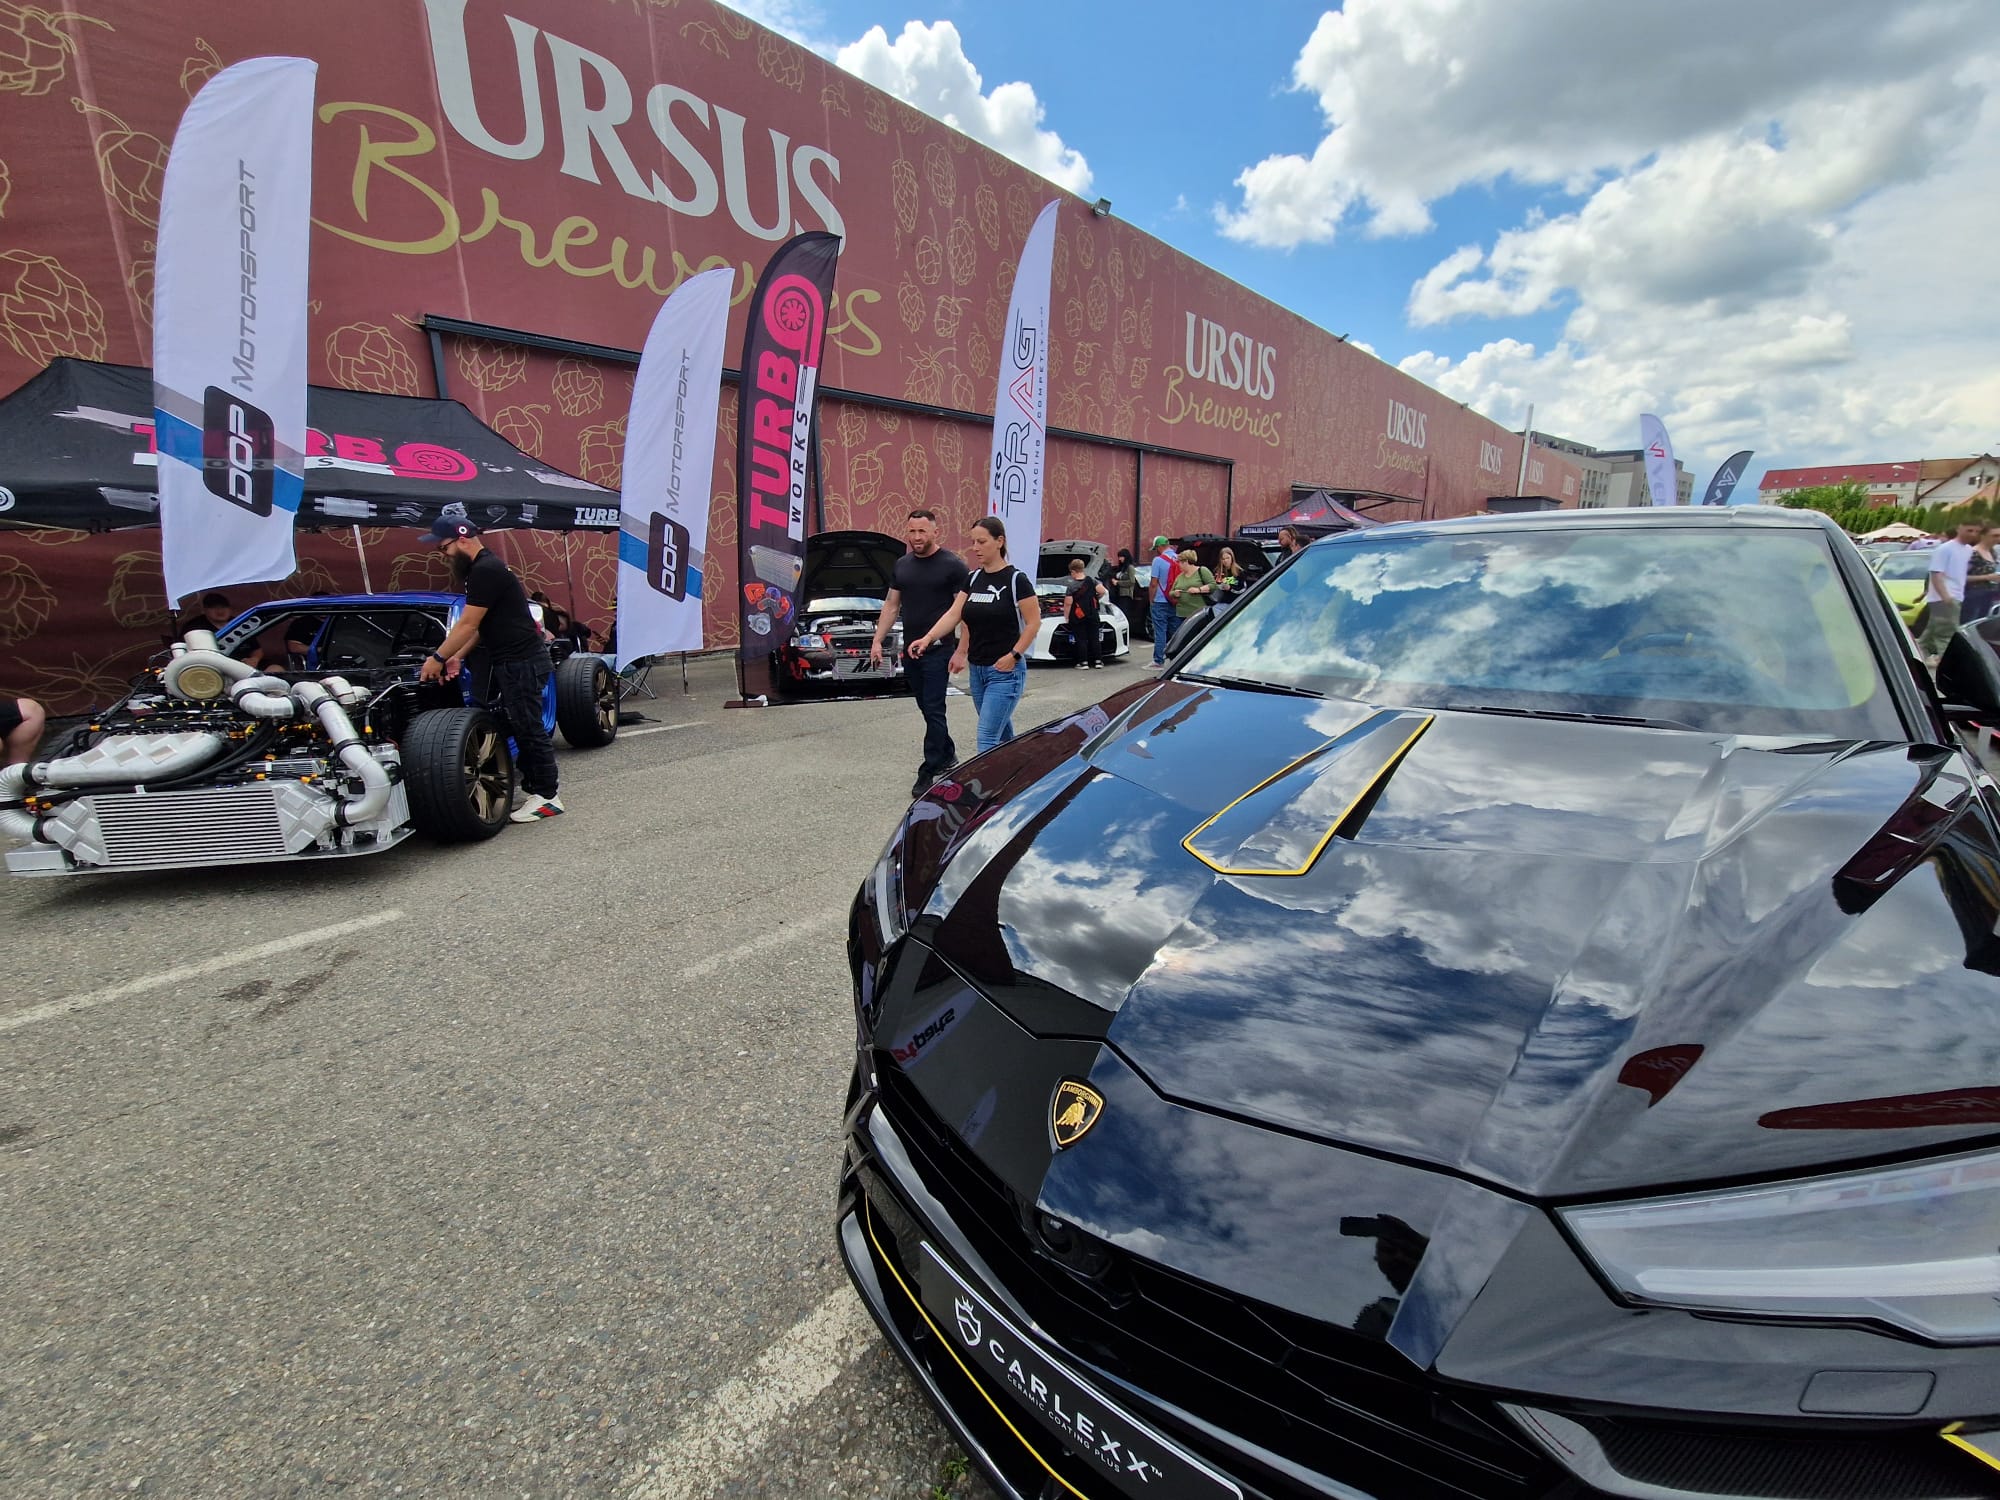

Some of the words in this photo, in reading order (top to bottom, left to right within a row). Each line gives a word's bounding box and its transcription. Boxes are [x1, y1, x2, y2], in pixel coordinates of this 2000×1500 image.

[425, 0, 846, 257] URSUS
[232, 159, 258, 393] MOTORSPORT
[1185, 311, 1277, 401] URSUS
[665, 348, 692, 515] MOTORSPORT
[1157, 365, 1282, 447] Breweries
[1386, 399, 1428, 449] URSUS
[228, 403, 255, 505] DOP
[791, 411, 808, 524] WORKS
[1032, 439, 1041, 495] RACING
[575, 507, 621, 521] TURB
[660, 522, 677, 594] DOP
[1007, 1373, 1045, 1411] CERAMIC
[1048, 1411, 1090, 1449] COATING
[1094, 1449, 1120, 1473] PLUS
